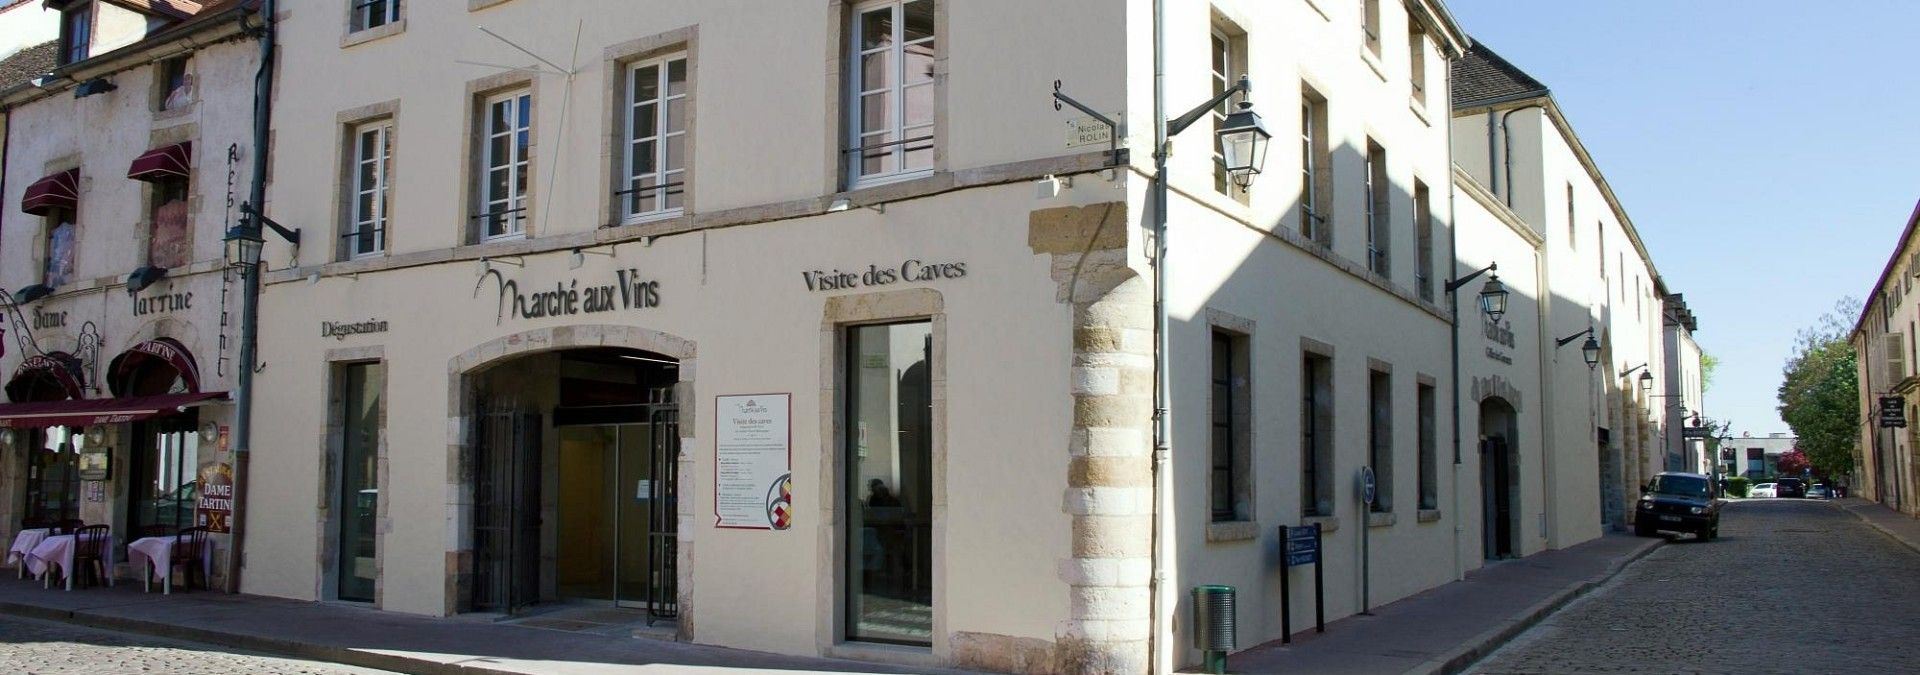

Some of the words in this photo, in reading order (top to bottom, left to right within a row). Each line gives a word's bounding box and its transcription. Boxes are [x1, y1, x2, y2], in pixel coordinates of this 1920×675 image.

[1080, 131, 1109, 143] ROLIN
[802, 268, 859, 292] Visite
[862, 264, 898, 286] des
[901, 259, 968, 283] Caves
[474, 268, 578, 326] Marché
[583, 285, 616, 314] aux
[616, 268, 661, 310] Vins
[321, 317, 388, 341] Dégustation
[204, 483, 231, 496] DAME
